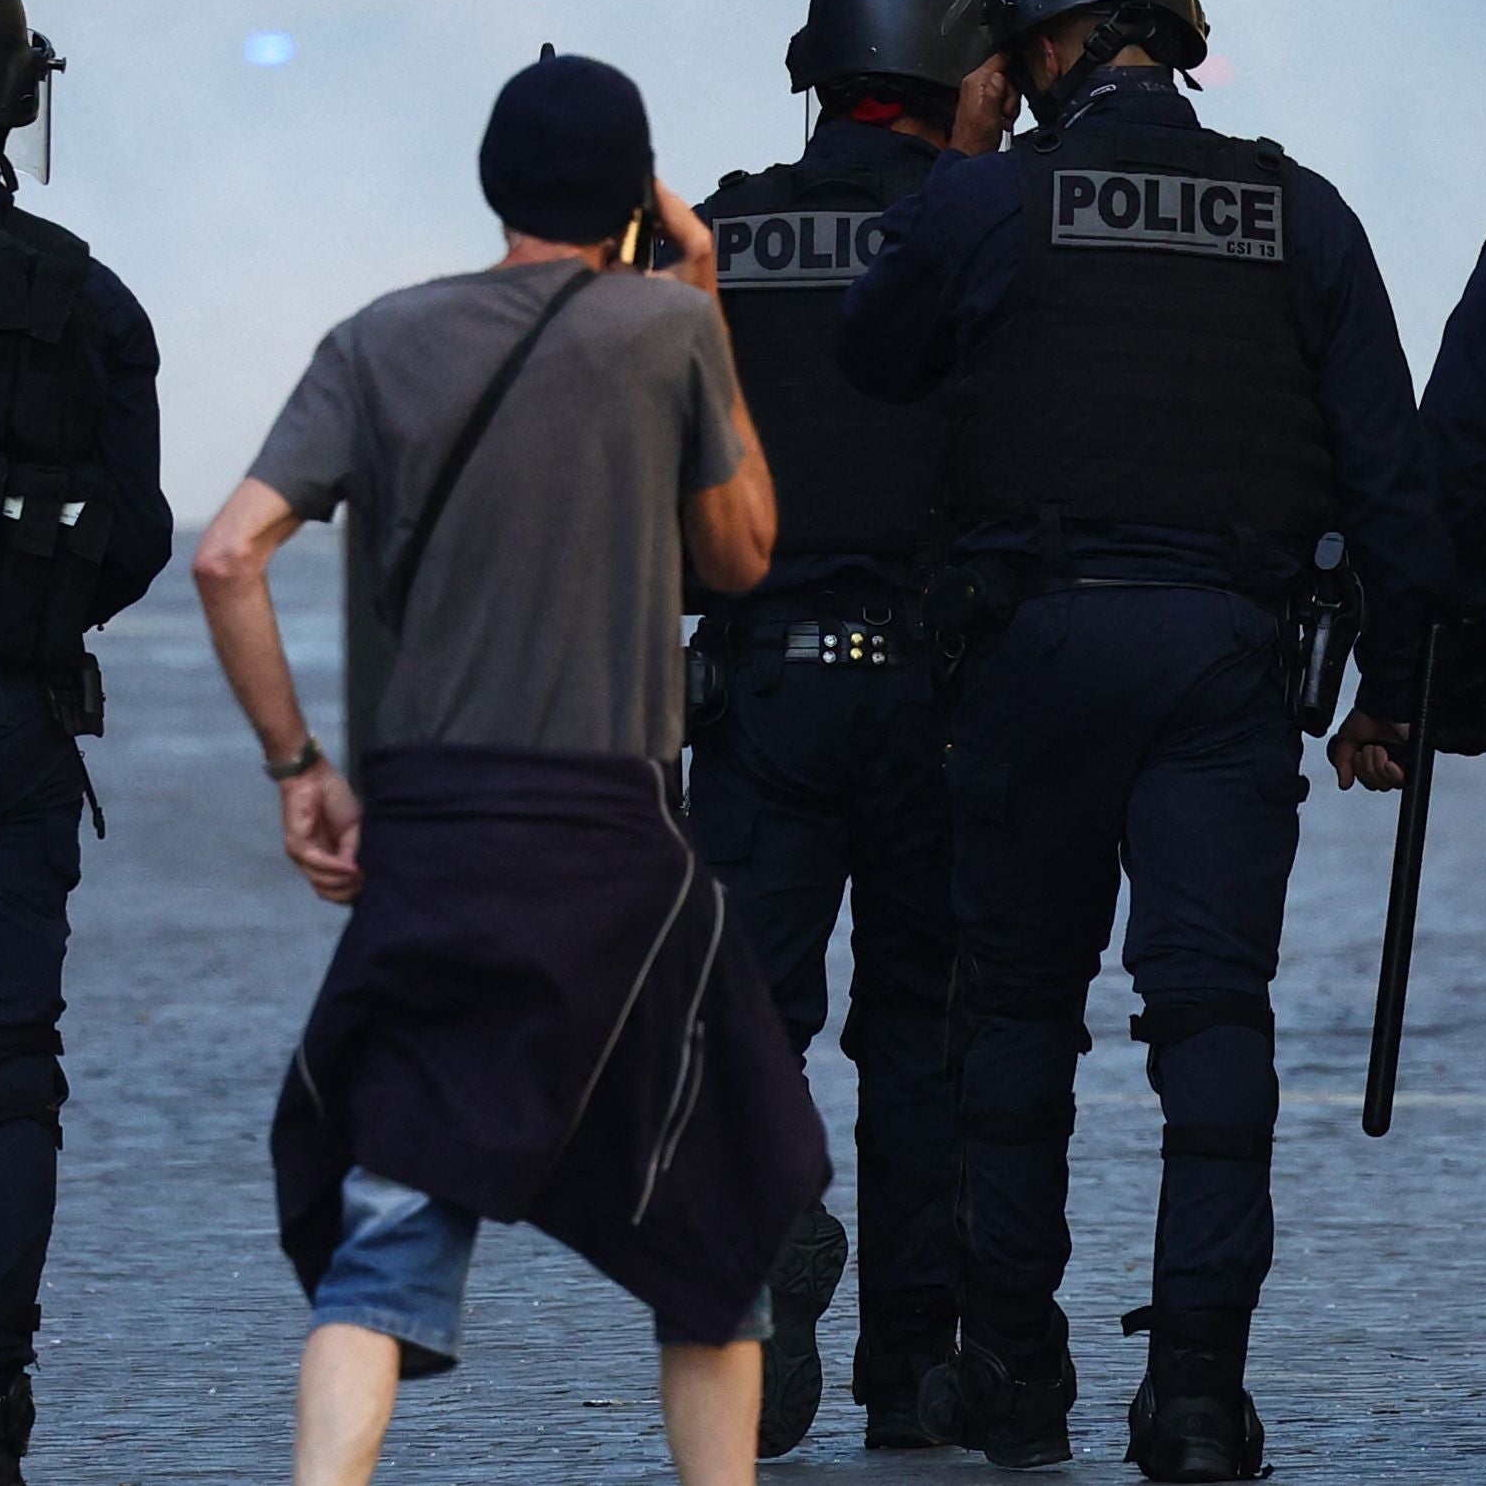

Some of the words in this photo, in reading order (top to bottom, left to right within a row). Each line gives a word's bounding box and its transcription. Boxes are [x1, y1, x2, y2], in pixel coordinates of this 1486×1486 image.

[1059, 175, 1276, 242] POLICE
[718, 217, 886, 271] POLIC
[1227, 240, 1252, 255] CSI
[1259, 244, 1275, 257] 13
